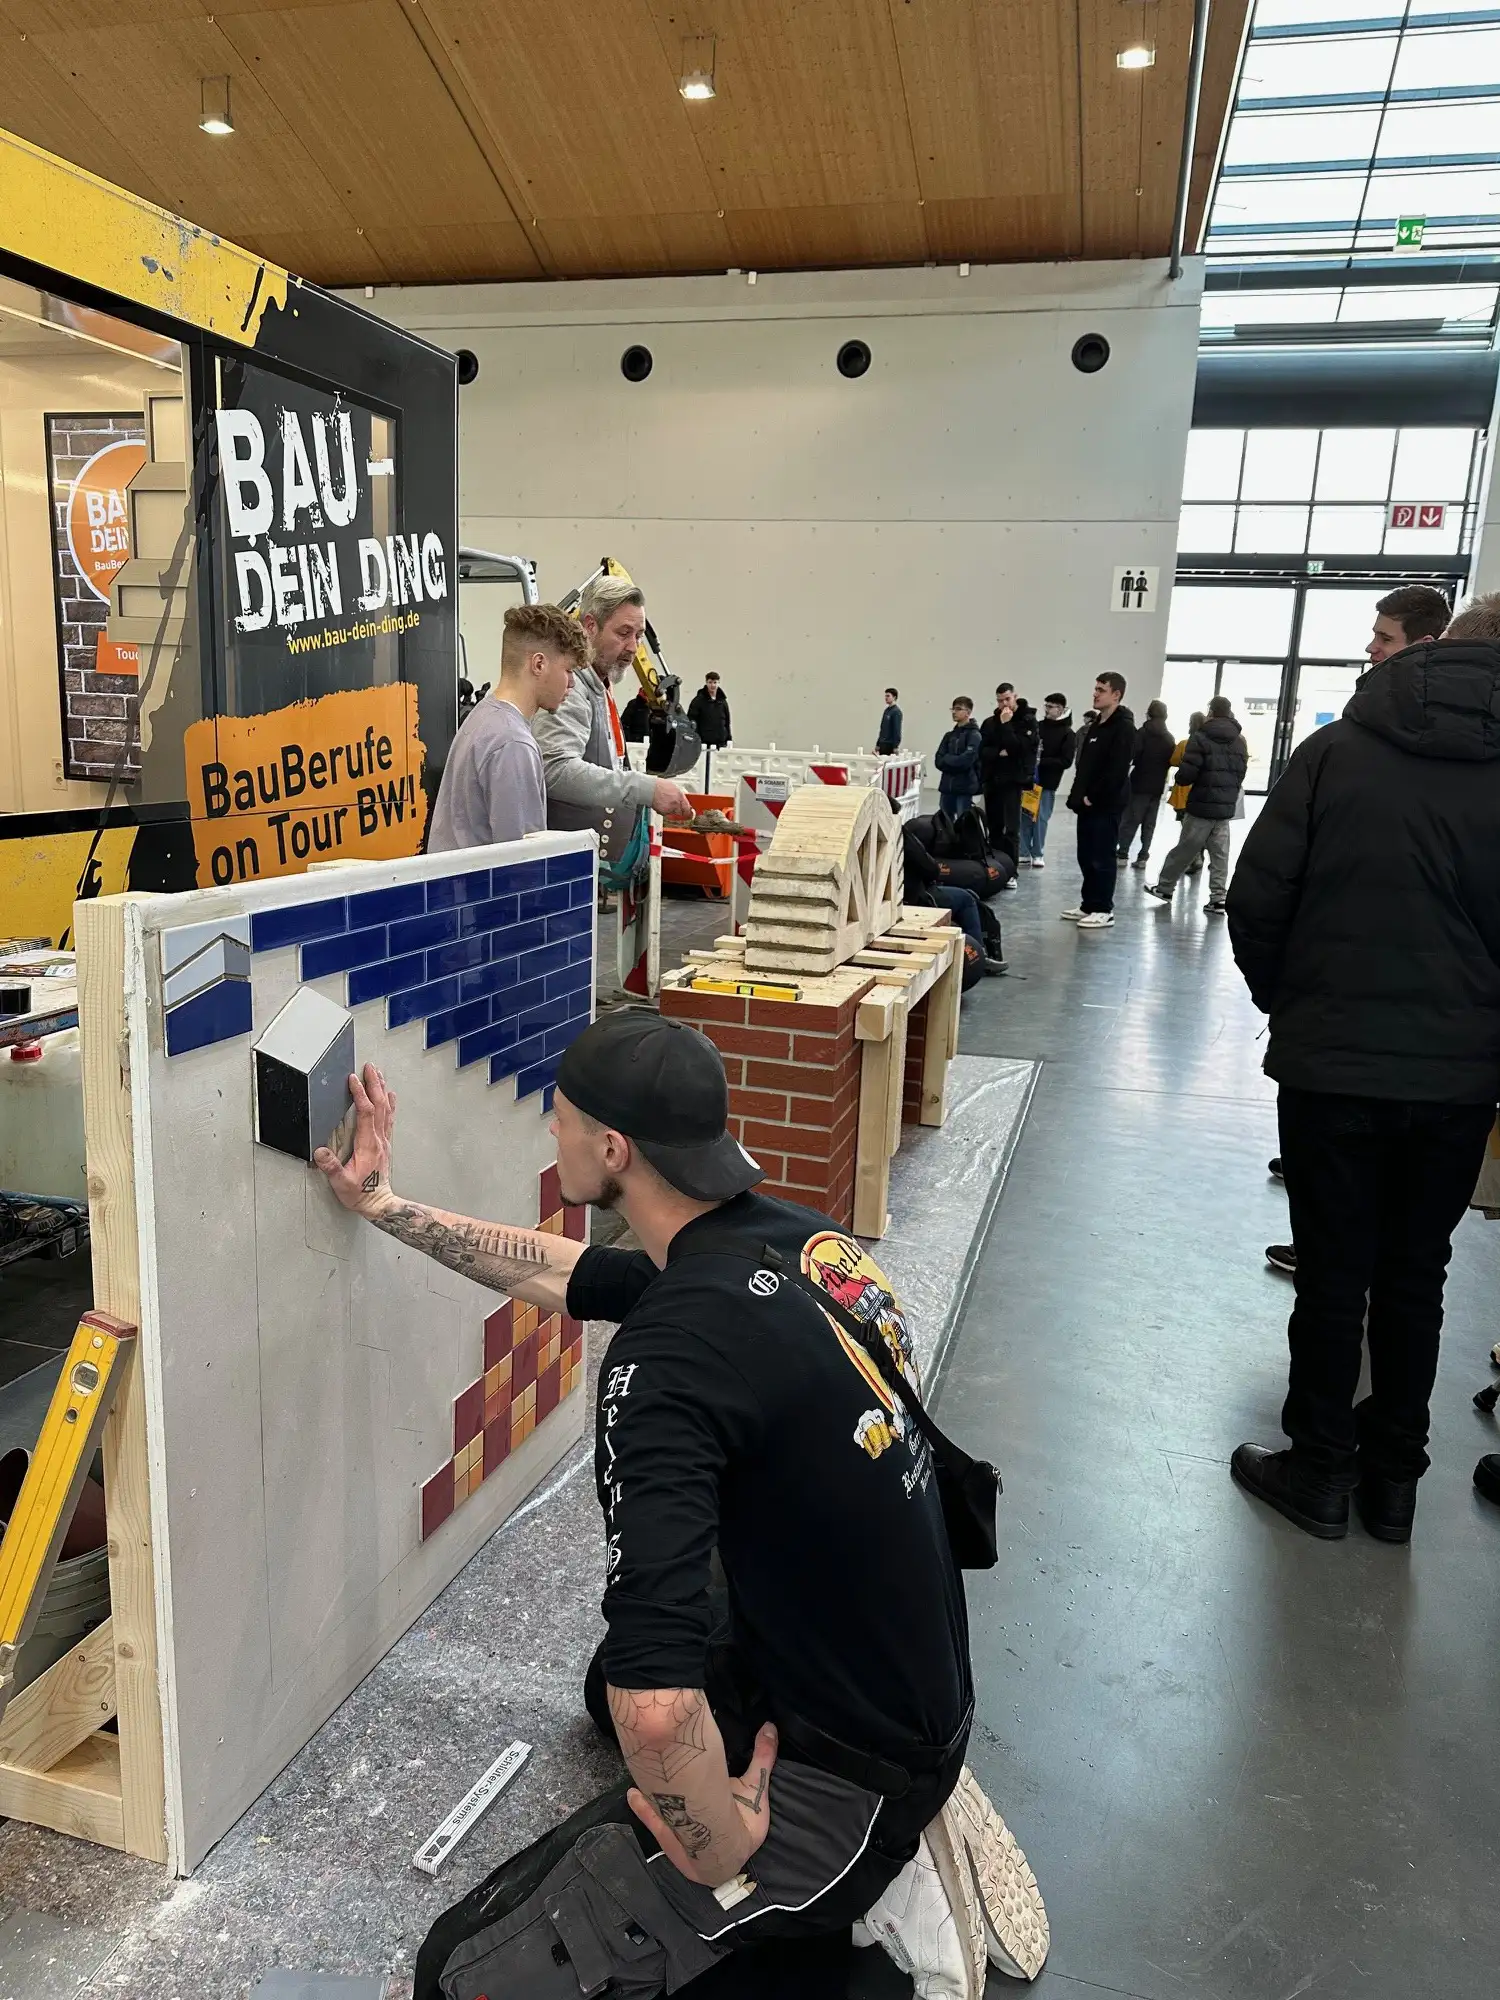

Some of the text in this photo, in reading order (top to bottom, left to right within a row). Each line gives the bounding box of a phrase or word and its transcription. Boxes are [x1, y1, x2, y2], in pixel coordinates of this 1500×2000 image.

[86, 488, 128, 527] BA
[215, 402, 395, 537] BAU-
[234, 532, 448, 633] DEIN DING
[287, 609, 420, 655] www.bau-dein-ding.de
[201, 725, 393, 819] BauBerufe
[211, 774, 417, 886] on Tour BW!
